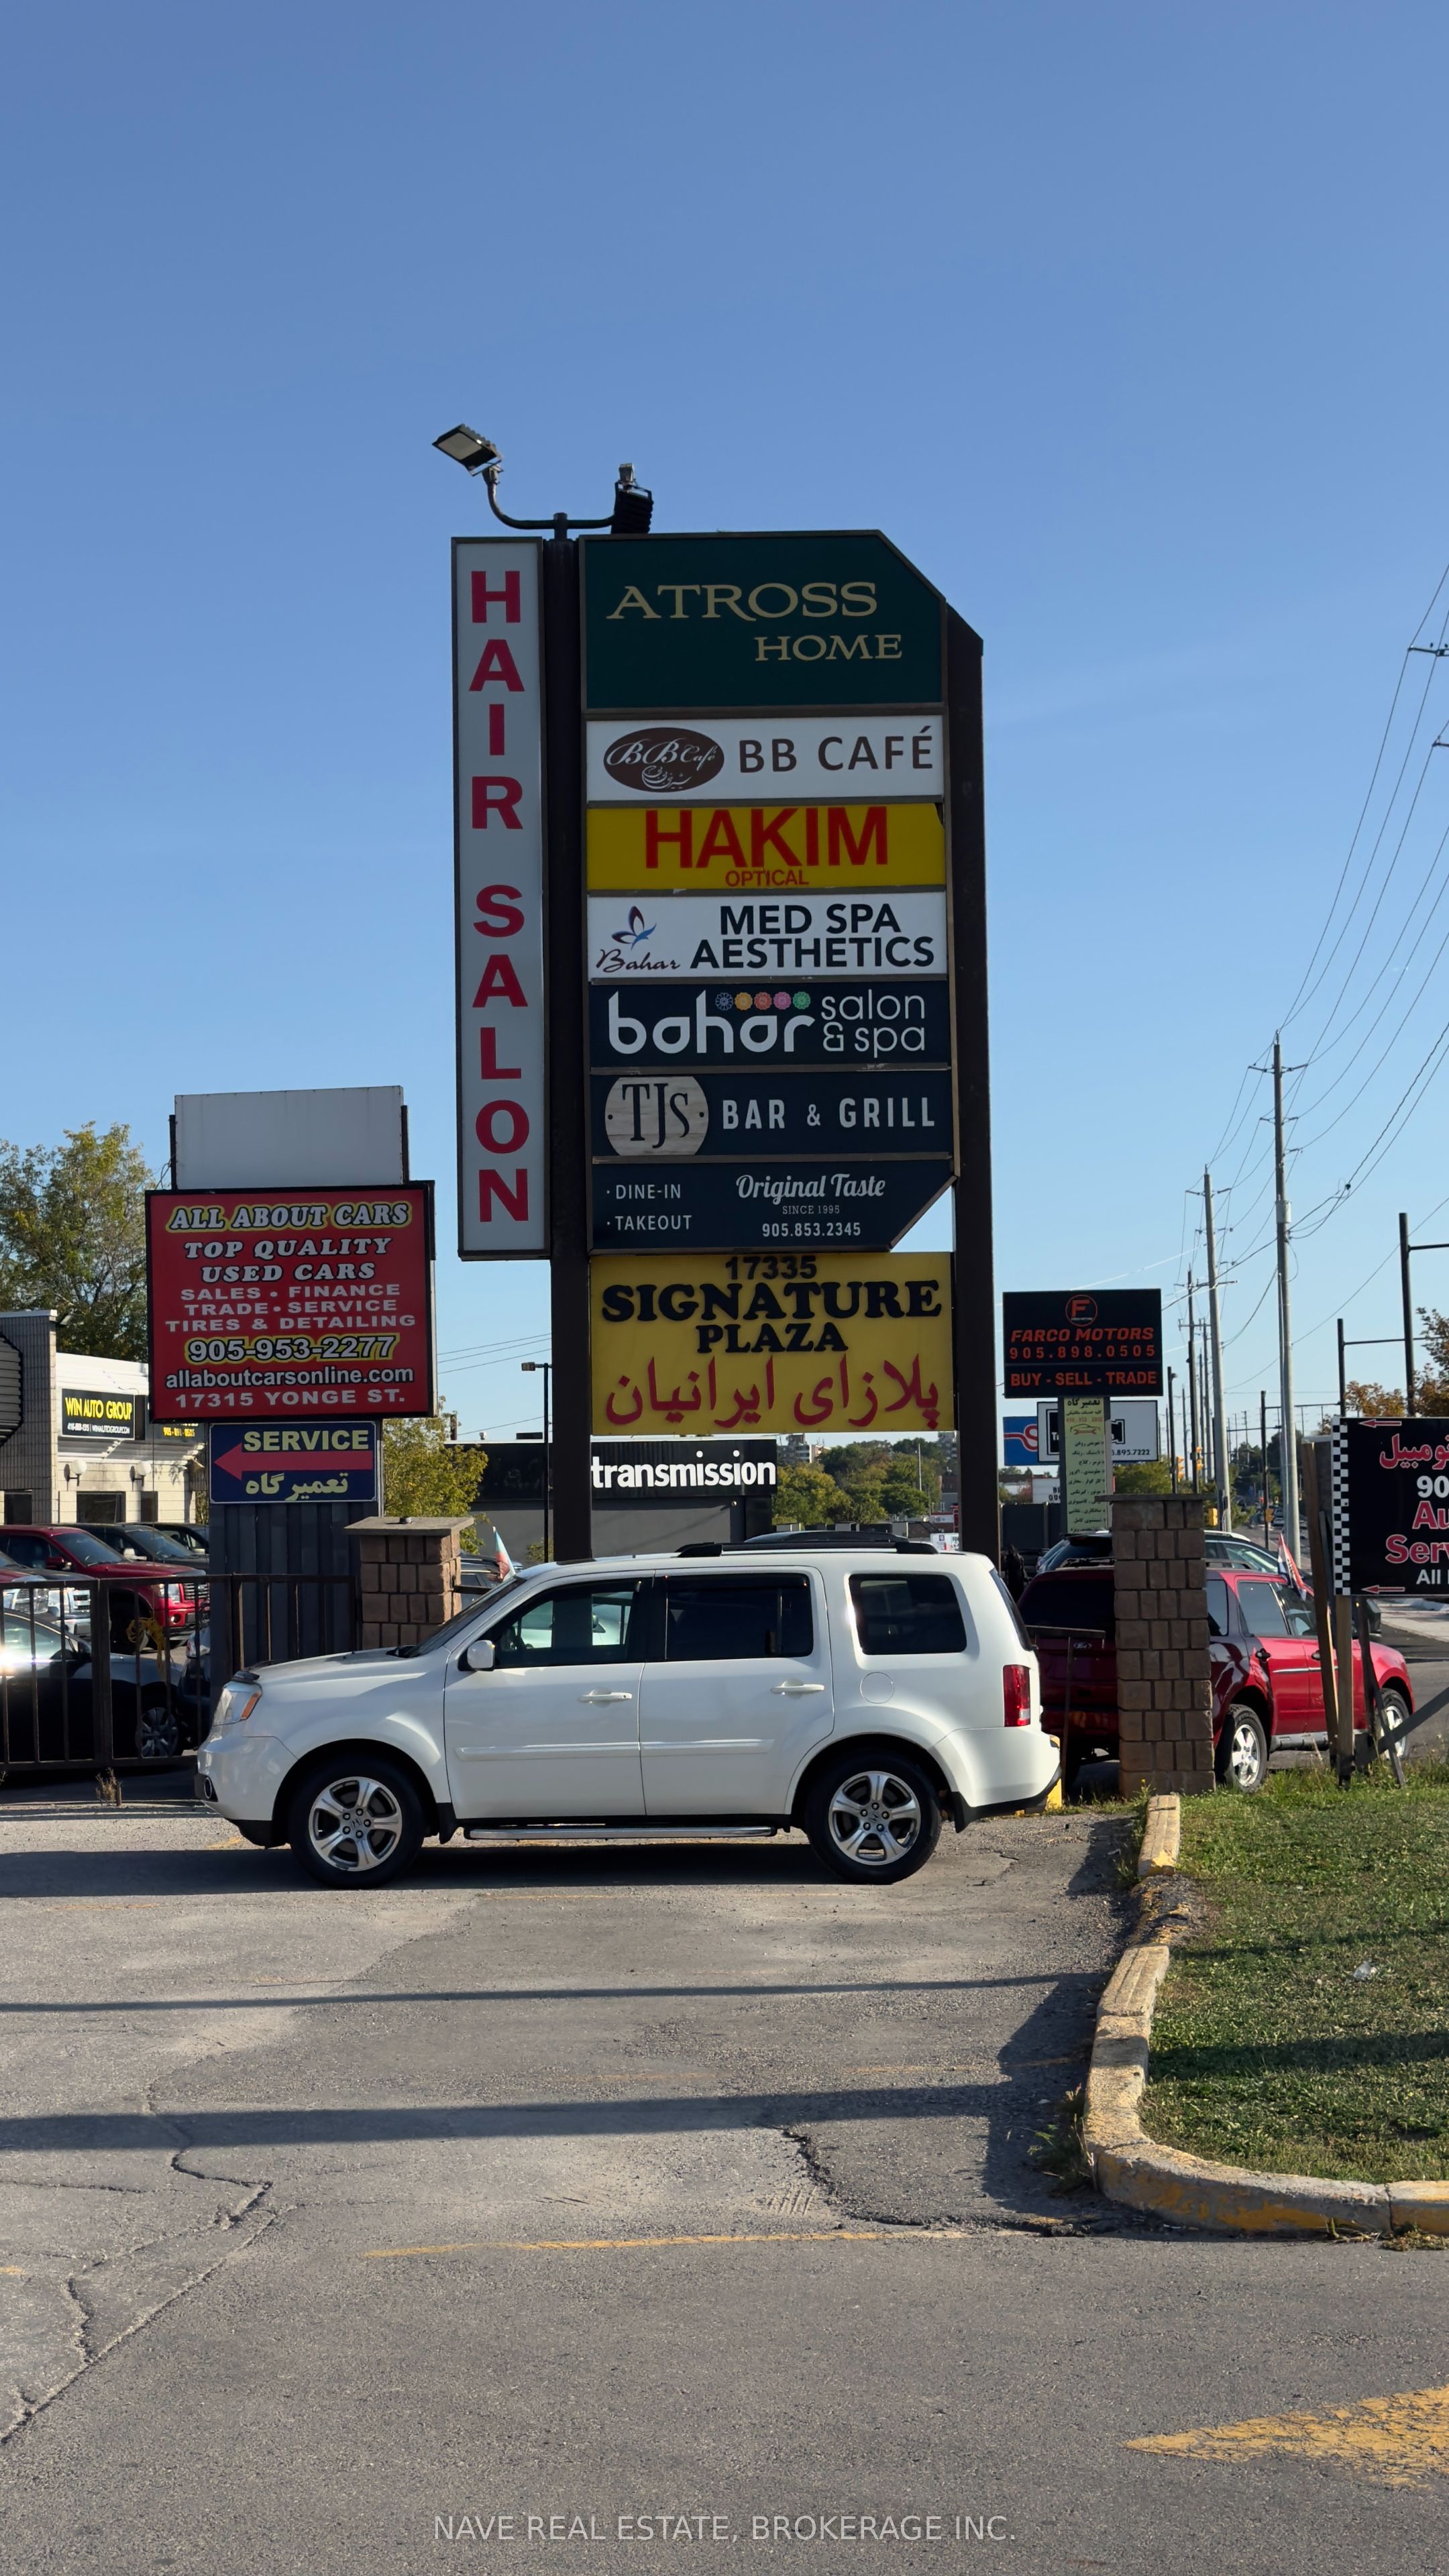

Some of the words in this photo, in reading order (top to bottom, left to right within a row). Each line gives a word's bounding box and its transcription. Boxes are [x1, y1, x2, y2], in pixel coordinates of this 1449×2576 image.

[606, 582, 877, 621] ATROSS
[755, 634, 902, 661] HOME
[469, 570, 525, 830] HAIR
[739, 738, 798, 773] BB
[818, 725, 933, 770] CAFÉ
[645, 806, 888, 869] HAKIM
[725, 867, 810, 887] OPTICAL
[720, 905, 812, 935] MED
[826, 904, 902, 933] SPA
[596, 948, 680, 973] Bahar
[690, 935, 934, 970] AESTHETICS
[820, 989, 926, 1020] salon
[608, 989, 816, 1055] bahar
[823, 1022, 845, 1052] &
[855, 1022, 926, 1058] spa
[473, 884, 530, 1222] SALON
[722, 1099, 786, 1130] BAR
[806, 1104, 821, 1126] &
[839, 1097, 936, 1128] GRILL
[615, 1184, 682, 1200] DINE-IN
[735, 1174, 826, 1205] Original
[830, 1173, 886, 1199] Taste
[169, 1206, 225, 1229] ALL
[232, 1205, 327, 1228] ABOUT
[335, 1203, 409, 1226] CARS
[782, 1205, 815, 1215] SINCE
[817, 1204, 841, 1214] 1995
[614, 1215, 692, 1232] TAKEOUT
[762, 1221, 861, 1238] 905.853.2345
[184, 1240, 244, 1258] TOP
[254, 1238, 392, 1260] QUALITY
[201, 1265, 283, 1283] USED
[294, 1263, 376, 1281] CARS
[725, 1256, 817, 1280] 17335
[180, 1287, 262, 1301] SALES
[288, 1284, 401, 1299] FINANCE
[601, 1280, 943, 1322] SIGNATURE
[184, 1303, 268, 1316] TRADE
[287, 1299, 397, 1313] SERVICE
[165, 1319, 240, 1332] TIRES
[252, 1318, 268, 1330] &
[280, 1315, 416, 1330] DETAILING
[1010, 1328, 1071, 1343] FARCO
[1075, 1327, 1155, 1341] MOTORS
[188, 1336, 396, 1362] 905-953-2277
[696, 1322, 849, 1354] PLAZA
[165, 1366, 415, 1389] allaboutcarsonline.com
[1010, 1373, 1042, 1386] BUY
[1055, 1372, 1093, 1385] SELL
[1106, 1371, 1157, 1385] TRADE
[176, 1392, 253, 1407] 17315
[264, 1389, 357, 1405] YONGE
[368, 1389, 405, 1403] ST.
[606, 1355, 774, 1428] ایرانیان
[65, 1397, 83, 1416] WIN
[83, 1399, 104, 1418] AUTO
[106, 1400, 132, 1420] GROUP
[243, 1430, 370, 1452] SERVICE
[591, 1450, 776, 1489] transmission
[1415, 1569, 1441, 1585] All
